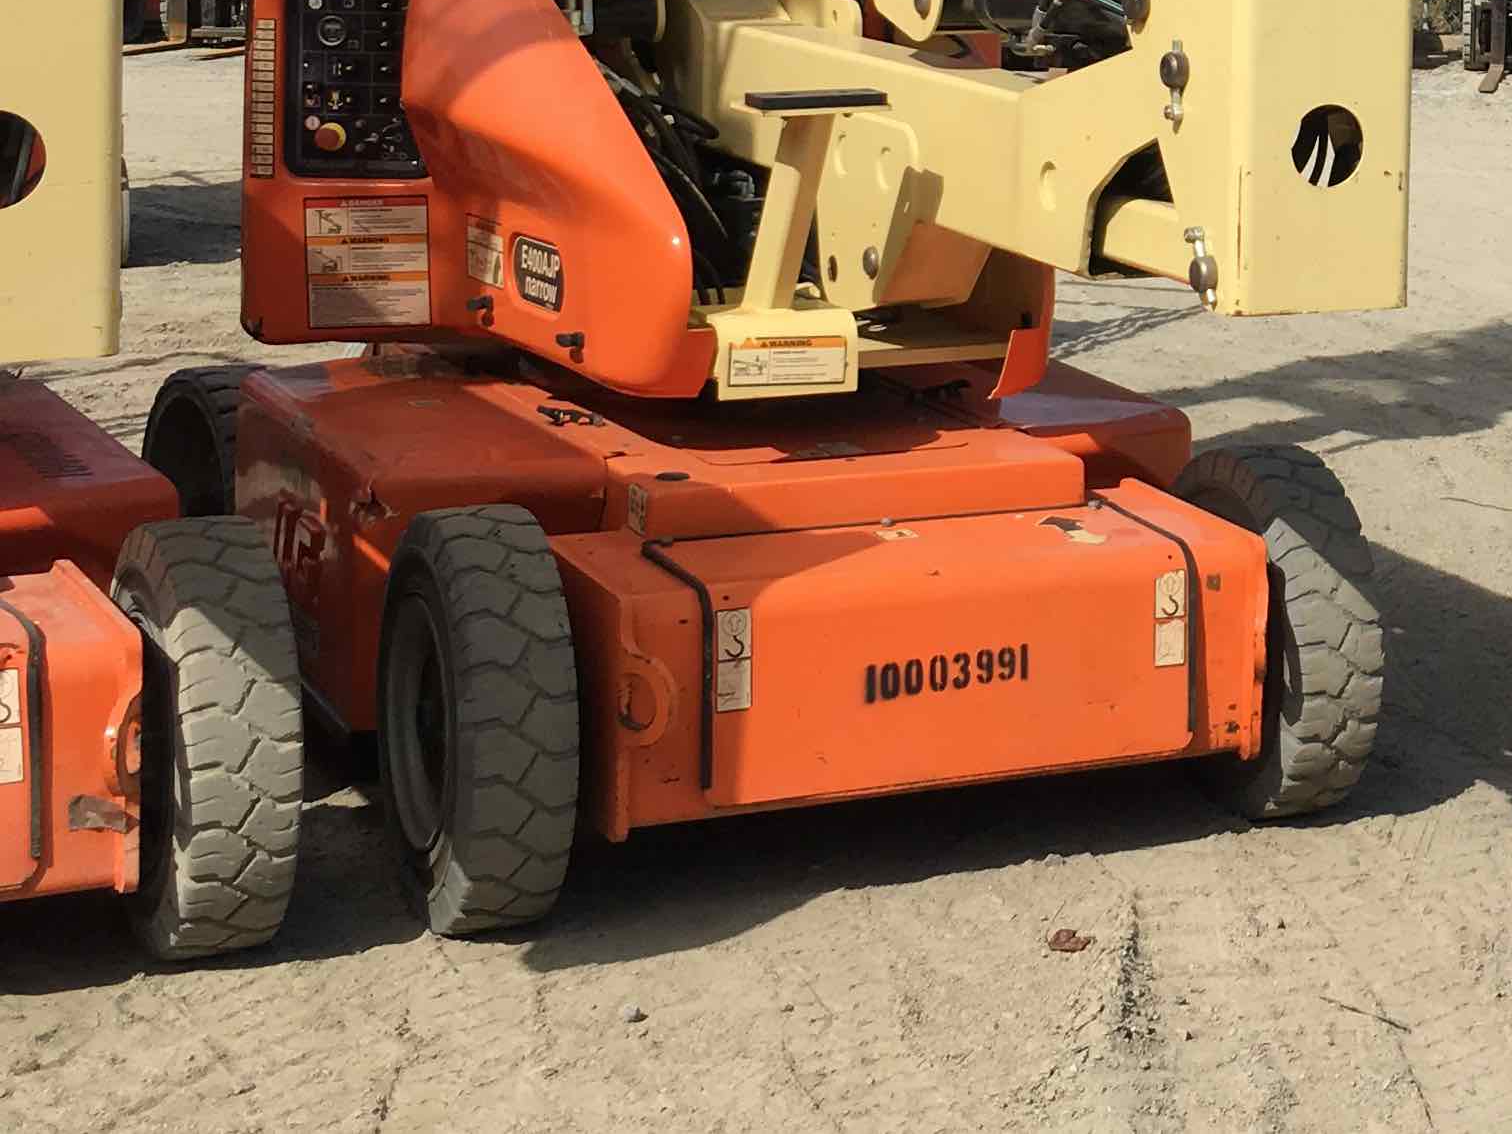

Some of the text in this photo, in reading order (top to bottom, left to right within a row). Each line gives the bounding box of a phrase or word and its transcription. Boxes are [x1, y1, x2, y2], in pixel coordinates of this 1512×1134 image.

[524, 275, 557, 304] narrow
[768, 339, 813, 348] WARNING
[864, 642, 1029, 705] 10003991
